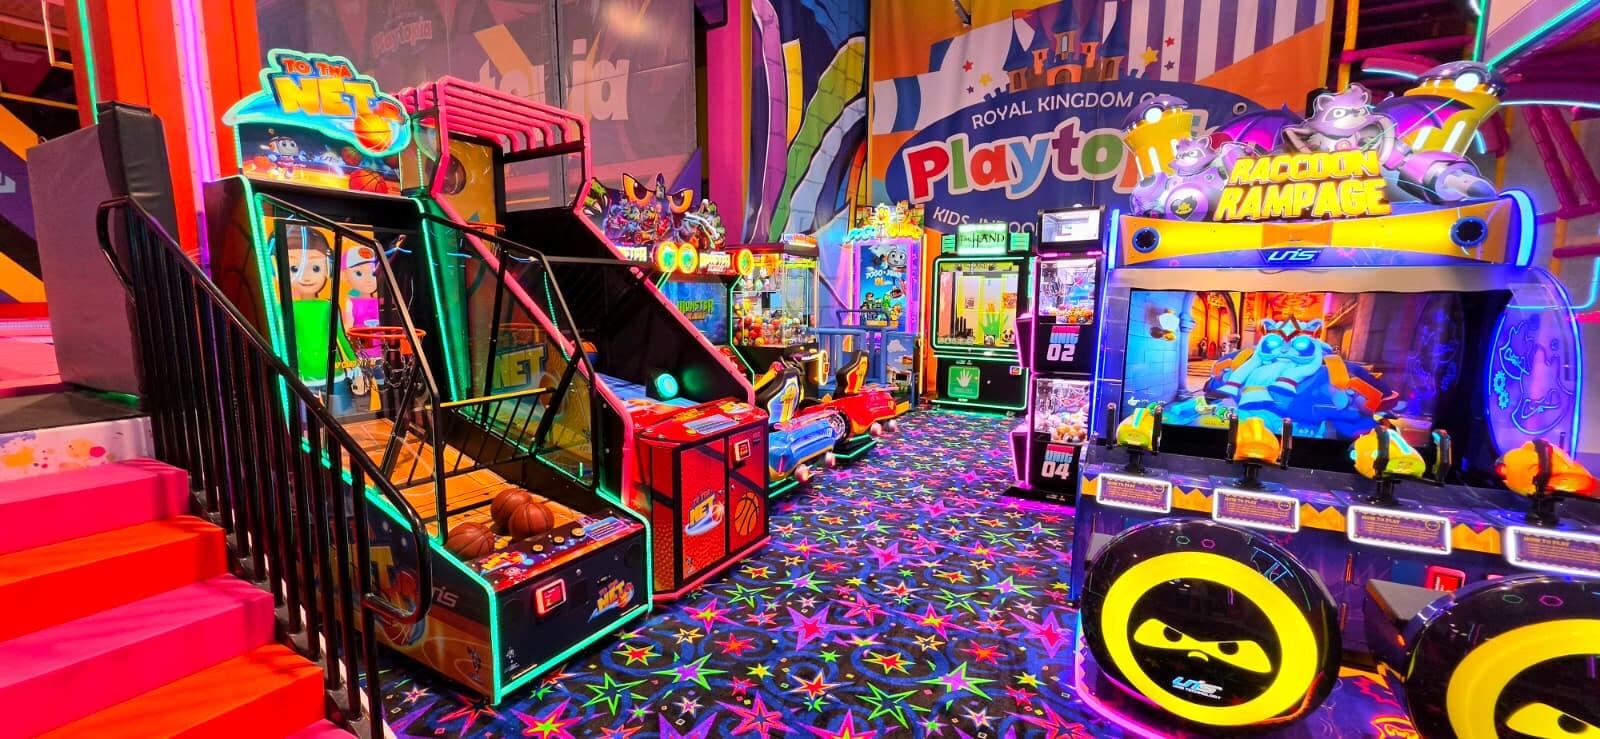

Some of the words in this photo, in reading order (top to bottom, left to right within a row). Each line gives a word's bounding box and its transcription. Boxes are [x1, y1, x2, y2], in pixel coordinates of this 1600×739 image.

[281, 58, 312, 75] TO
[273, 77, 376, 117] NET
[971, 101, 1032, 129] ROYAL
[1037, 91, 1134, 112] KINGDOM
[904, 116, 1205, 204] Playto
[1229, 150, 1381, 185] RACCOON
[932, 206, 970, 226] KIDS
[1213, 177, 1392, 222] RAMPAGE
[1046, 343, 1076, 361] 02
[1041, 460, 1070, 480] 04
